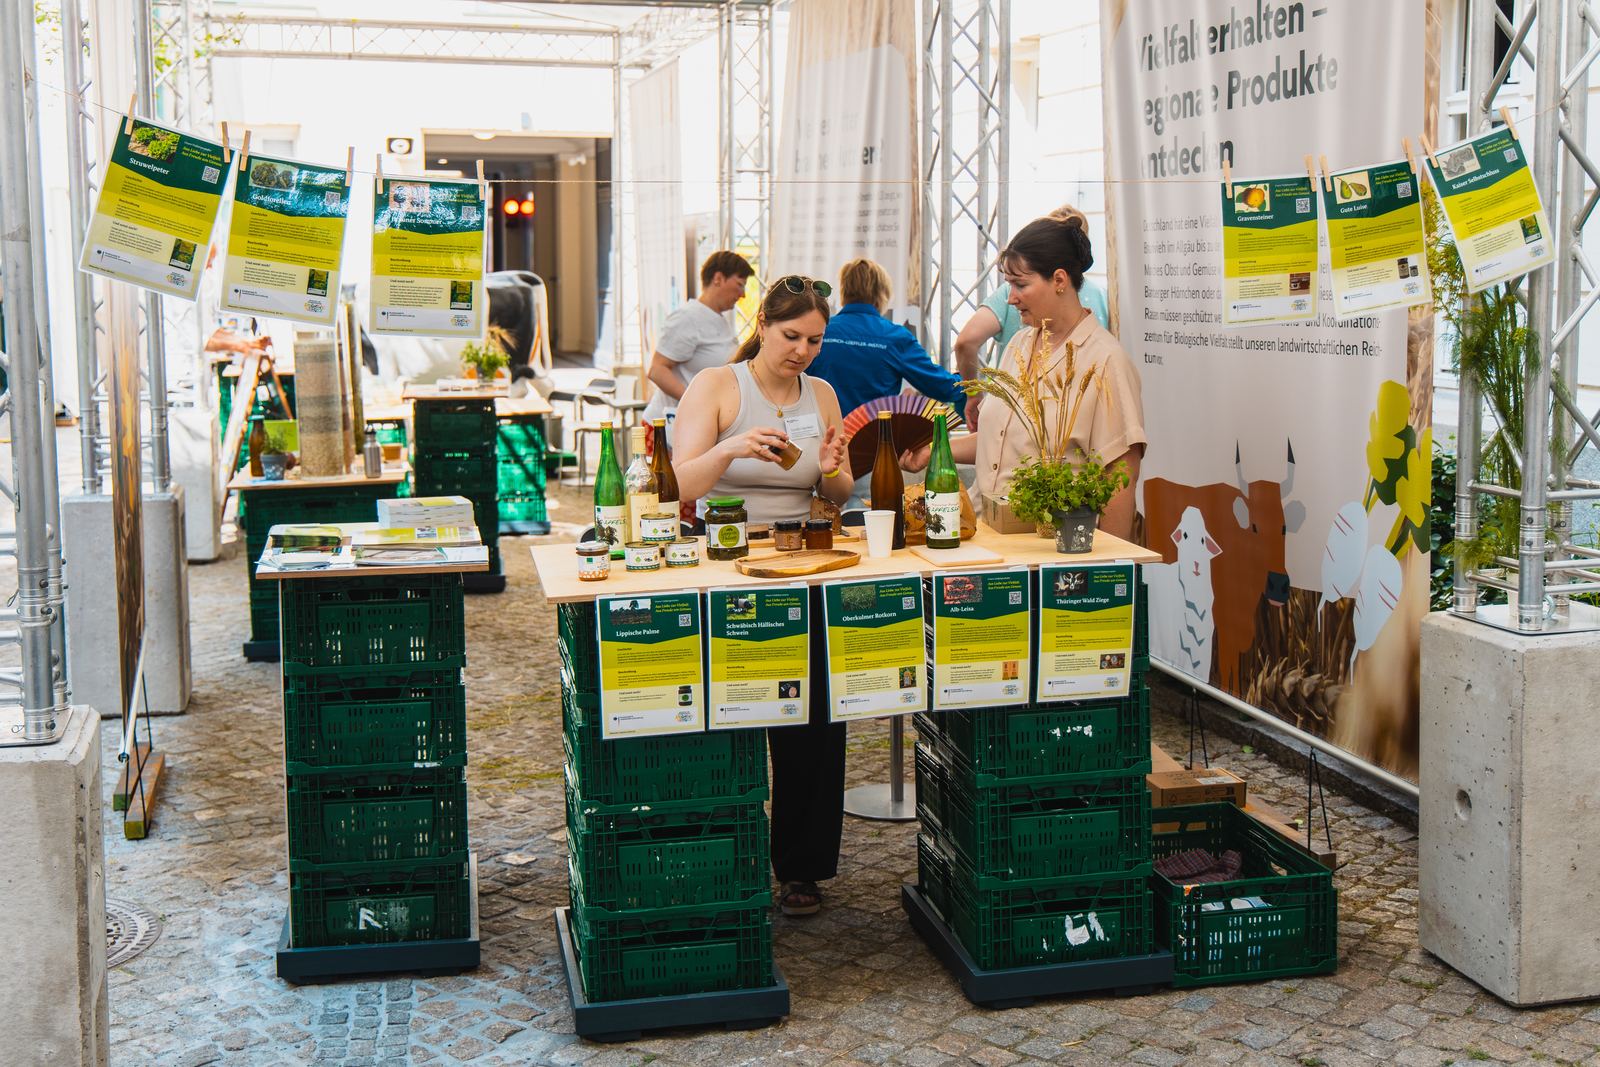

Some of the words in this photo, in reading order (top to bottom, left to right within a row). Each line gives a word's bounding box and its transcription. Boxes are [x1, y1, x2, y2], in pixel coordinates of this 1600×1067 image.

[1207, 0, 1304, 56] erhalten
[1226, 50, 1339, 111] Produkte
[129, 157, 170, 177] Struwelpeter
[1339, 206, 1354, 214] Gute
[1237, 213, 1274, 222] Gravensteiner
[1196, 240, 1206, 253] bis
[1183, 309, 1213, 326] geschützt
[1163, 330, 1172, 344] für
[1174, 332, 1208, 348] Biologische
[1245, 338, 1276, 351] unseren
[1278, 338, 1358, 356] landwirtschaftlichen
[1096, 597, 1110, 605] Ziege
[842, 614, 874, 622] Oberkulmer
[874, 611, 897, 619] Rotkorn
[616, 629, 642, 638] Lippische
